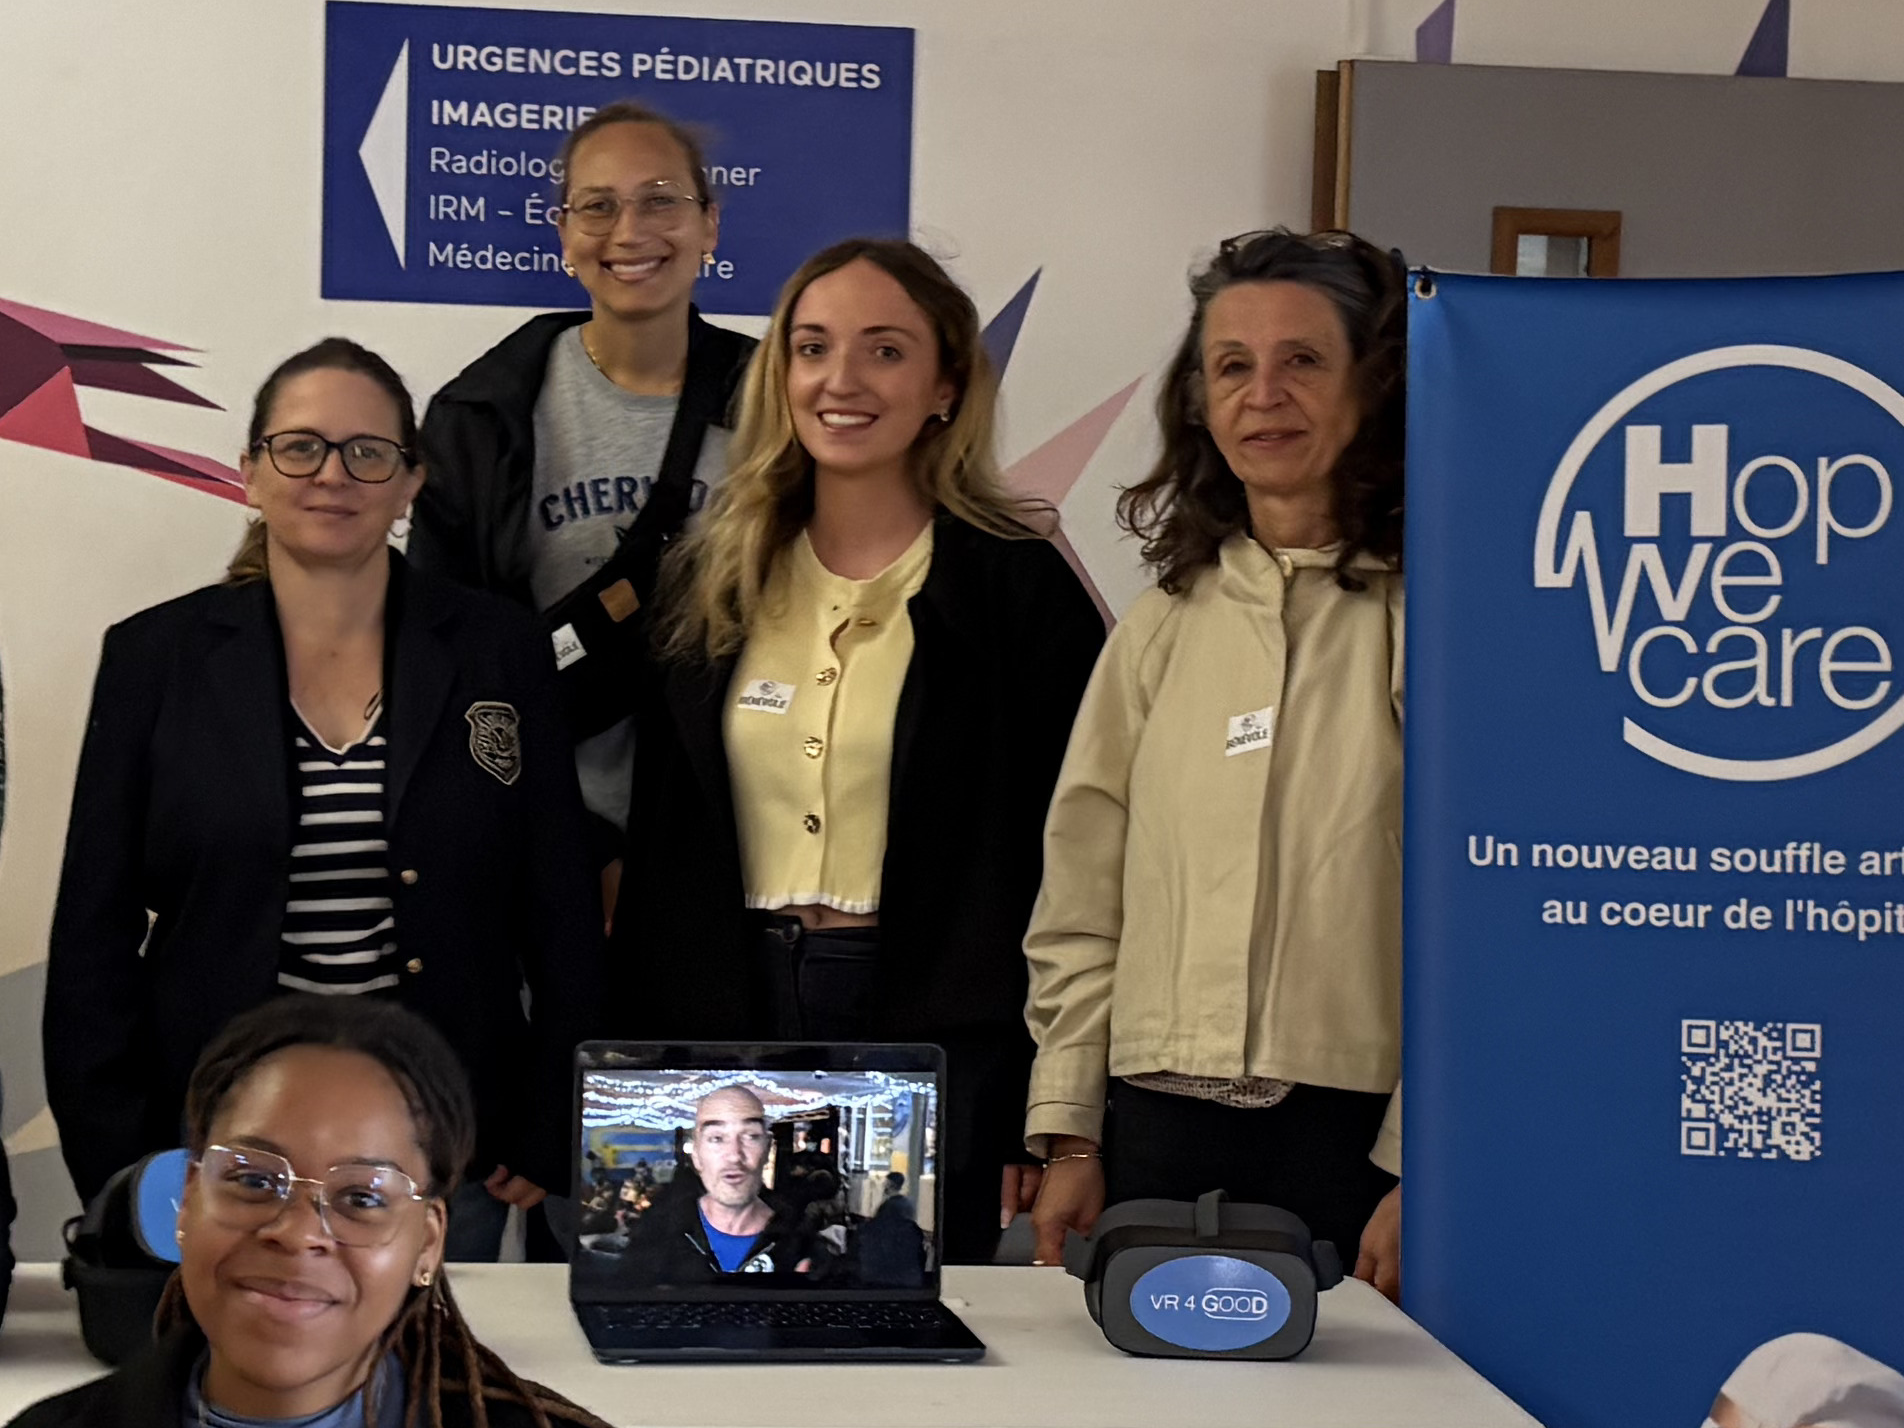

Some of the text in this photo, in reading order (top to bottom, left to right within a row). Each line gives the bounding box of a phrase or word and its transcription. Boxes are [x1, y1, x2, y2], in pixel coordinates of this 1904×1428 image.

[431, 42, 882, 89] URGENCES PÉDIATRIQUES
[429, 193, 486, 222] IRM
[1623, 423, 1893, 565] Hop
[1628, 625, 1893, 711] care
[1467, 835, 1519, 867] Un
[1531, 842, 1698, 871] nouveau
[1709, 841, 1847, 875] souffle
[1541, 898, 1588, 925] au
[1600, 900, 1713, 928] coeur
[1723, 897, 1773, 930] de
[1150, 1293, 1269, 1315] VR 4 GOOD
